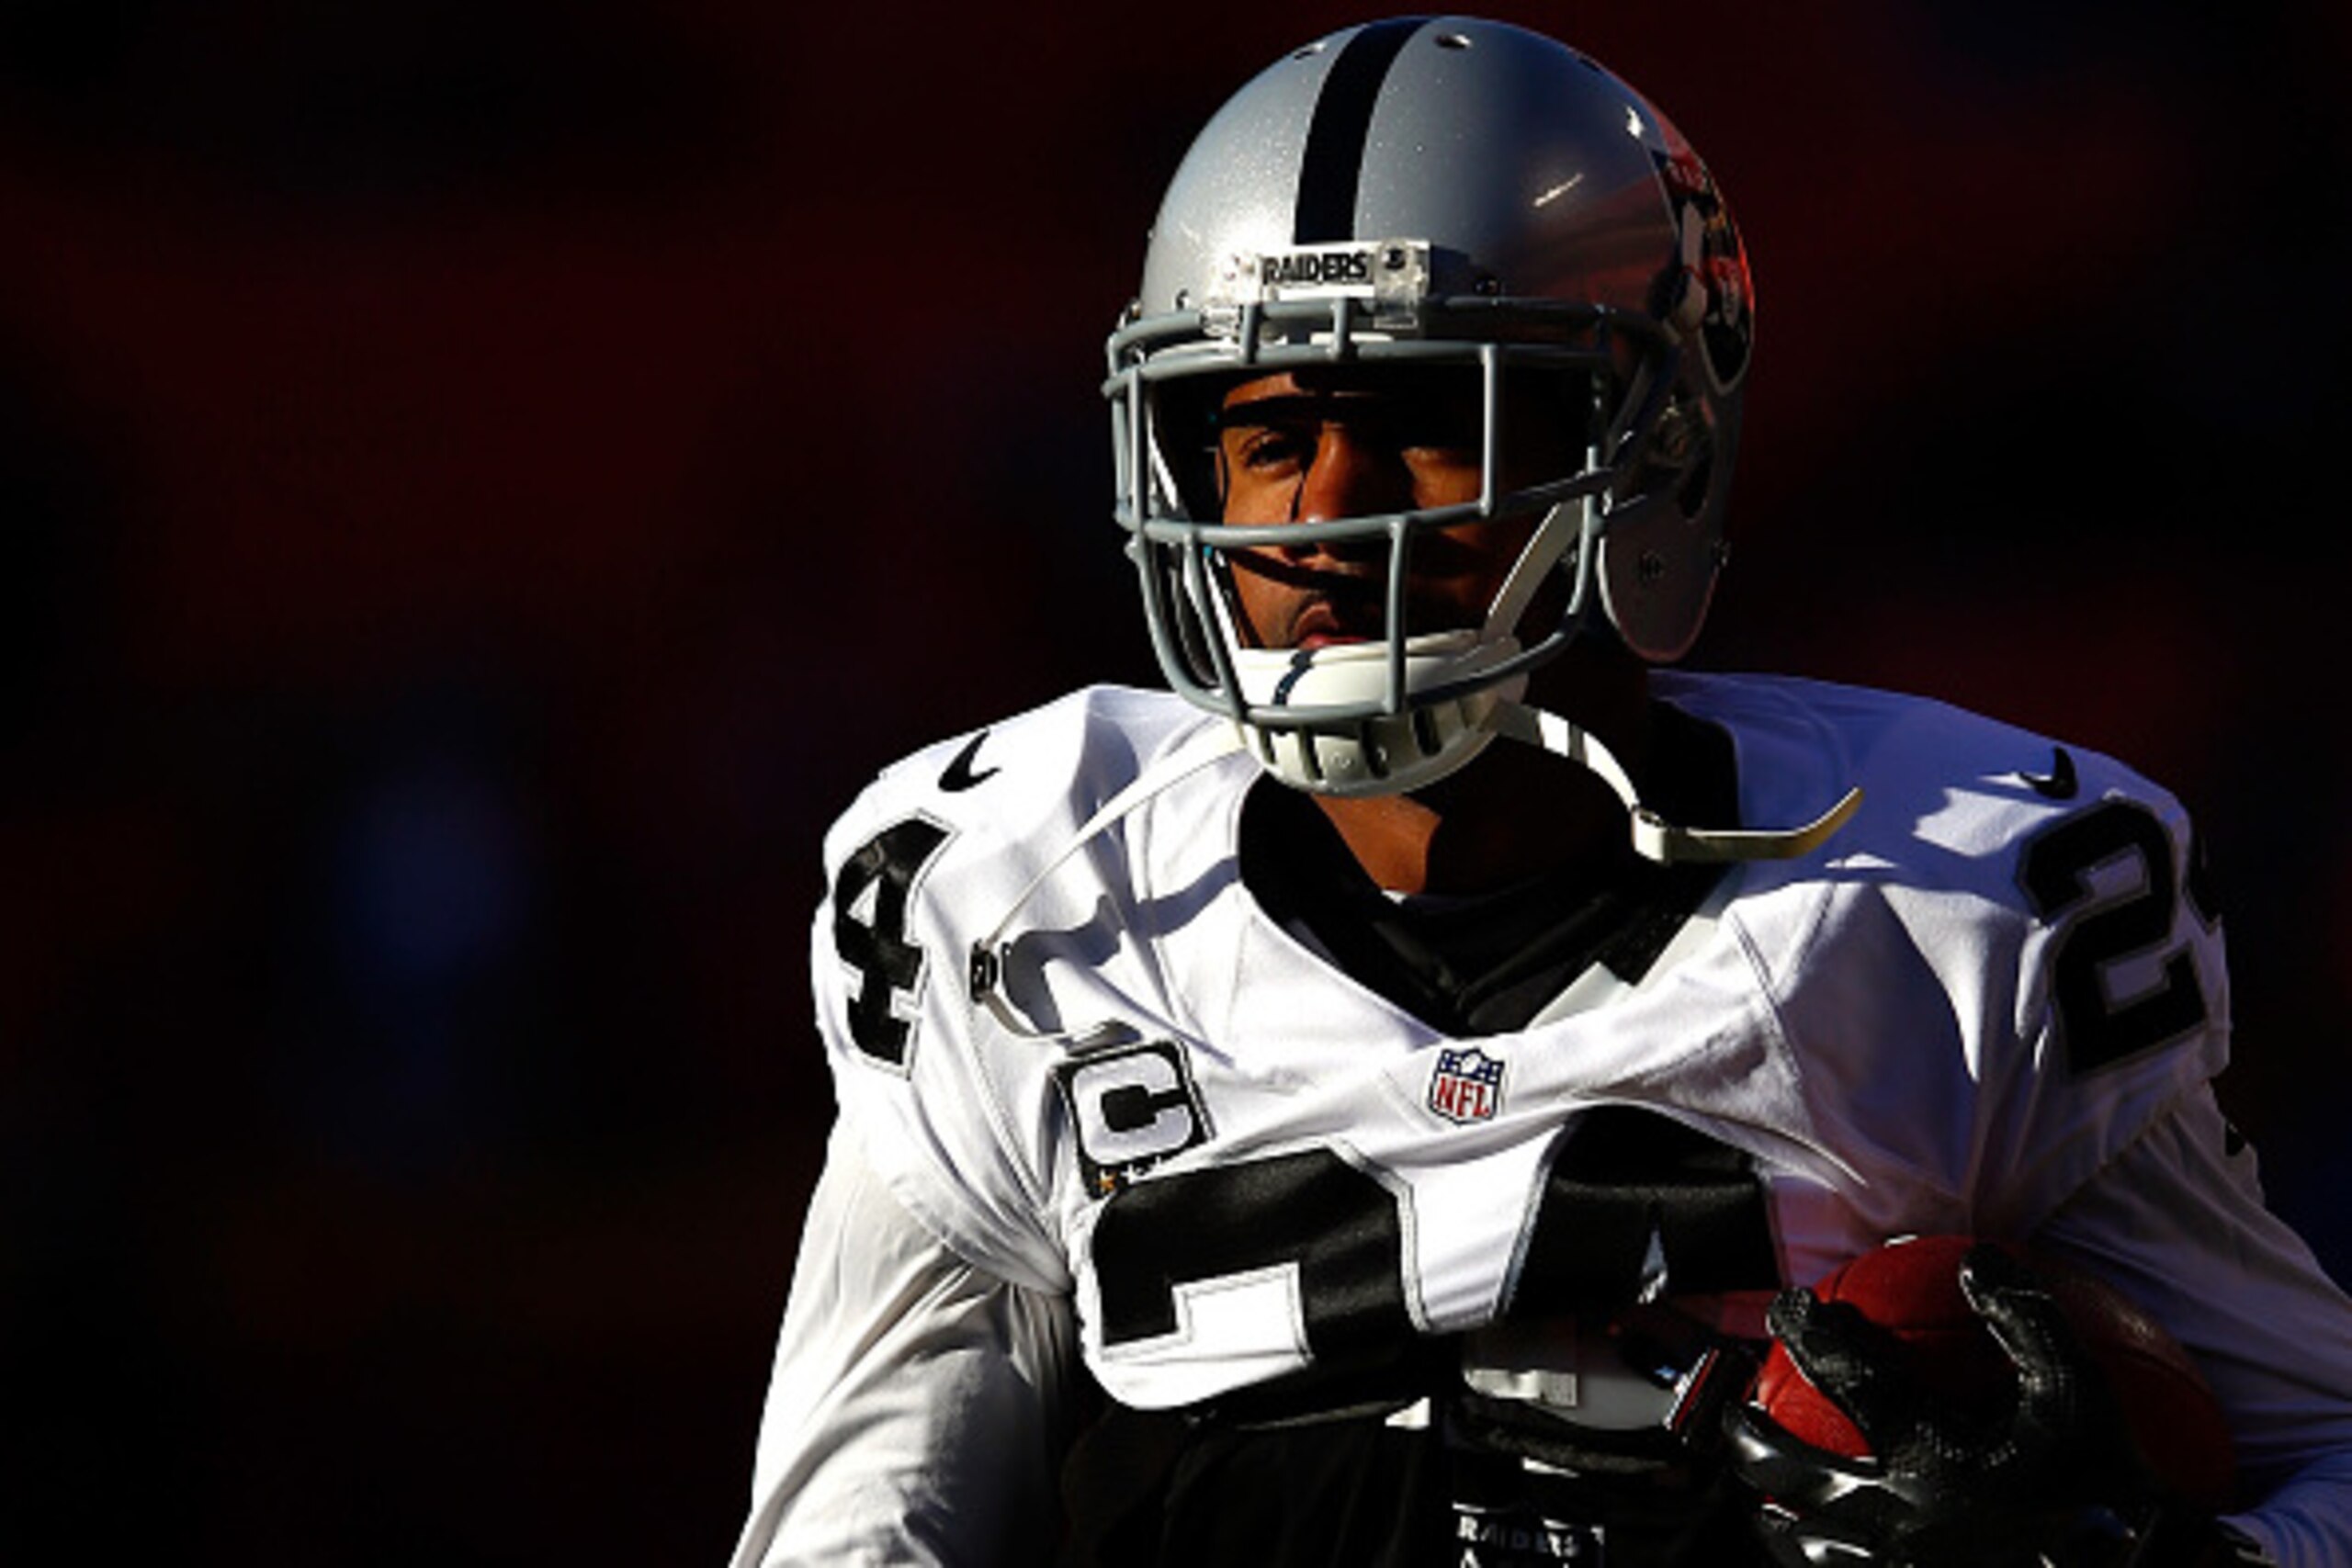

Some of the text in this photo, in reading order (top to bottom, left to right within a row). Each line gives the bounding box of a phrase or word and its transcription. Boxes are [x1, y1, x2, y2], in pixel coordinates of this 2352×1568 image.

[1261, 250, 1367, 285] RAIDERS
[836, 819, 948, 1064] 4
[1071, 1044, 1194, 1168] C
[1435, 1077, 1490, 1117] NFL
